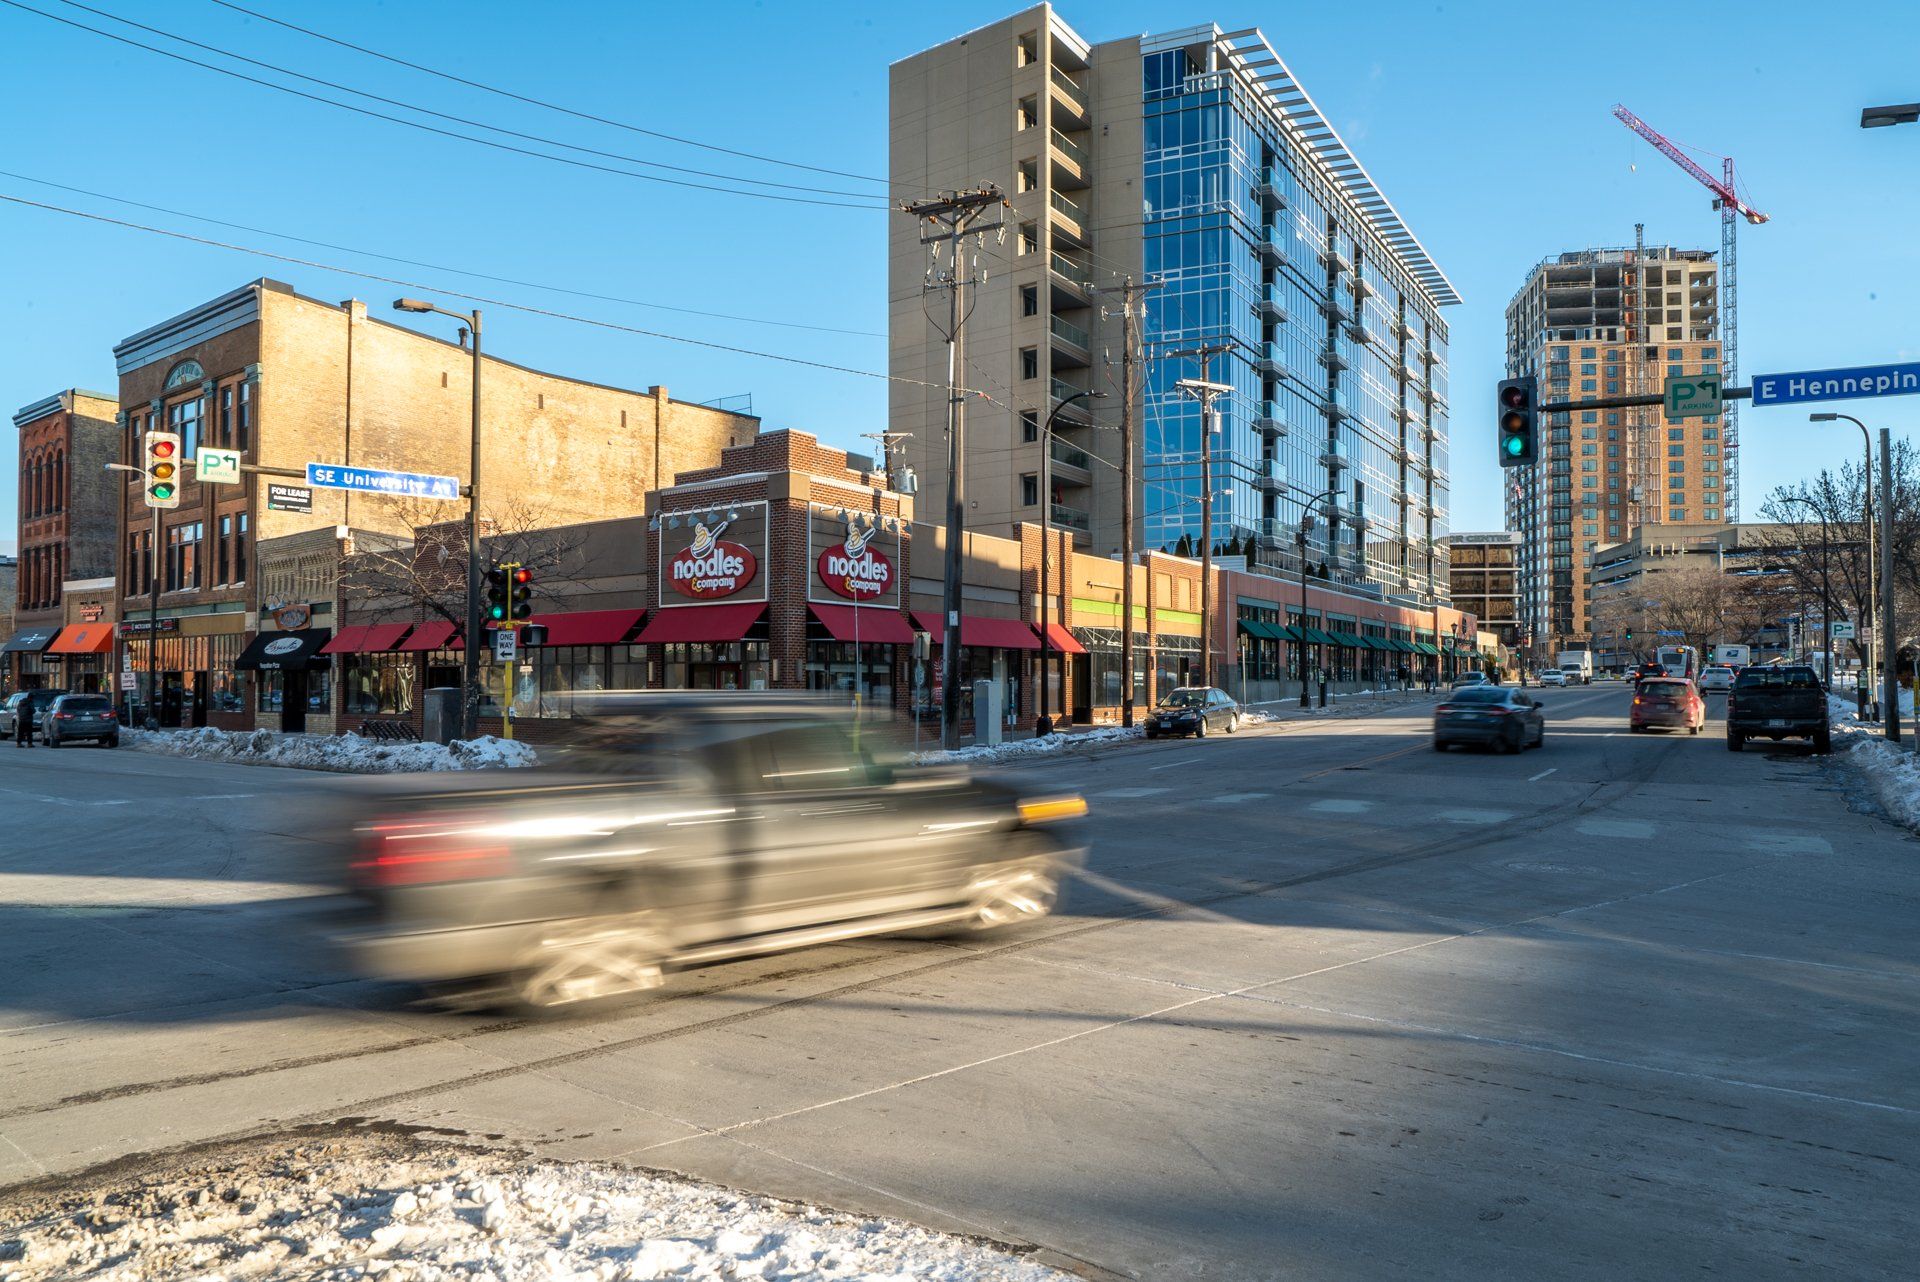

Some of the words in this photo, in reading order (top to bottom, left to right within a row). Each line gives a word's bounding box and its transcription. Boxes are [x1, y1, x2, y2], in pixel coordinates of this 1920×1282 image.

[1762, 381, 1777, 399] E
[1789, 370, 1917, 396] Hennepin
[315, 469, 335, 483] SE
[271, 486, 286, 495] FOR
[287, 488, 310, 498] LEASE
[1466, 534, 1511, 542] CENTRE
[674, 548, 745, 579] noodles
[828, 552, 888, 581] noodles
